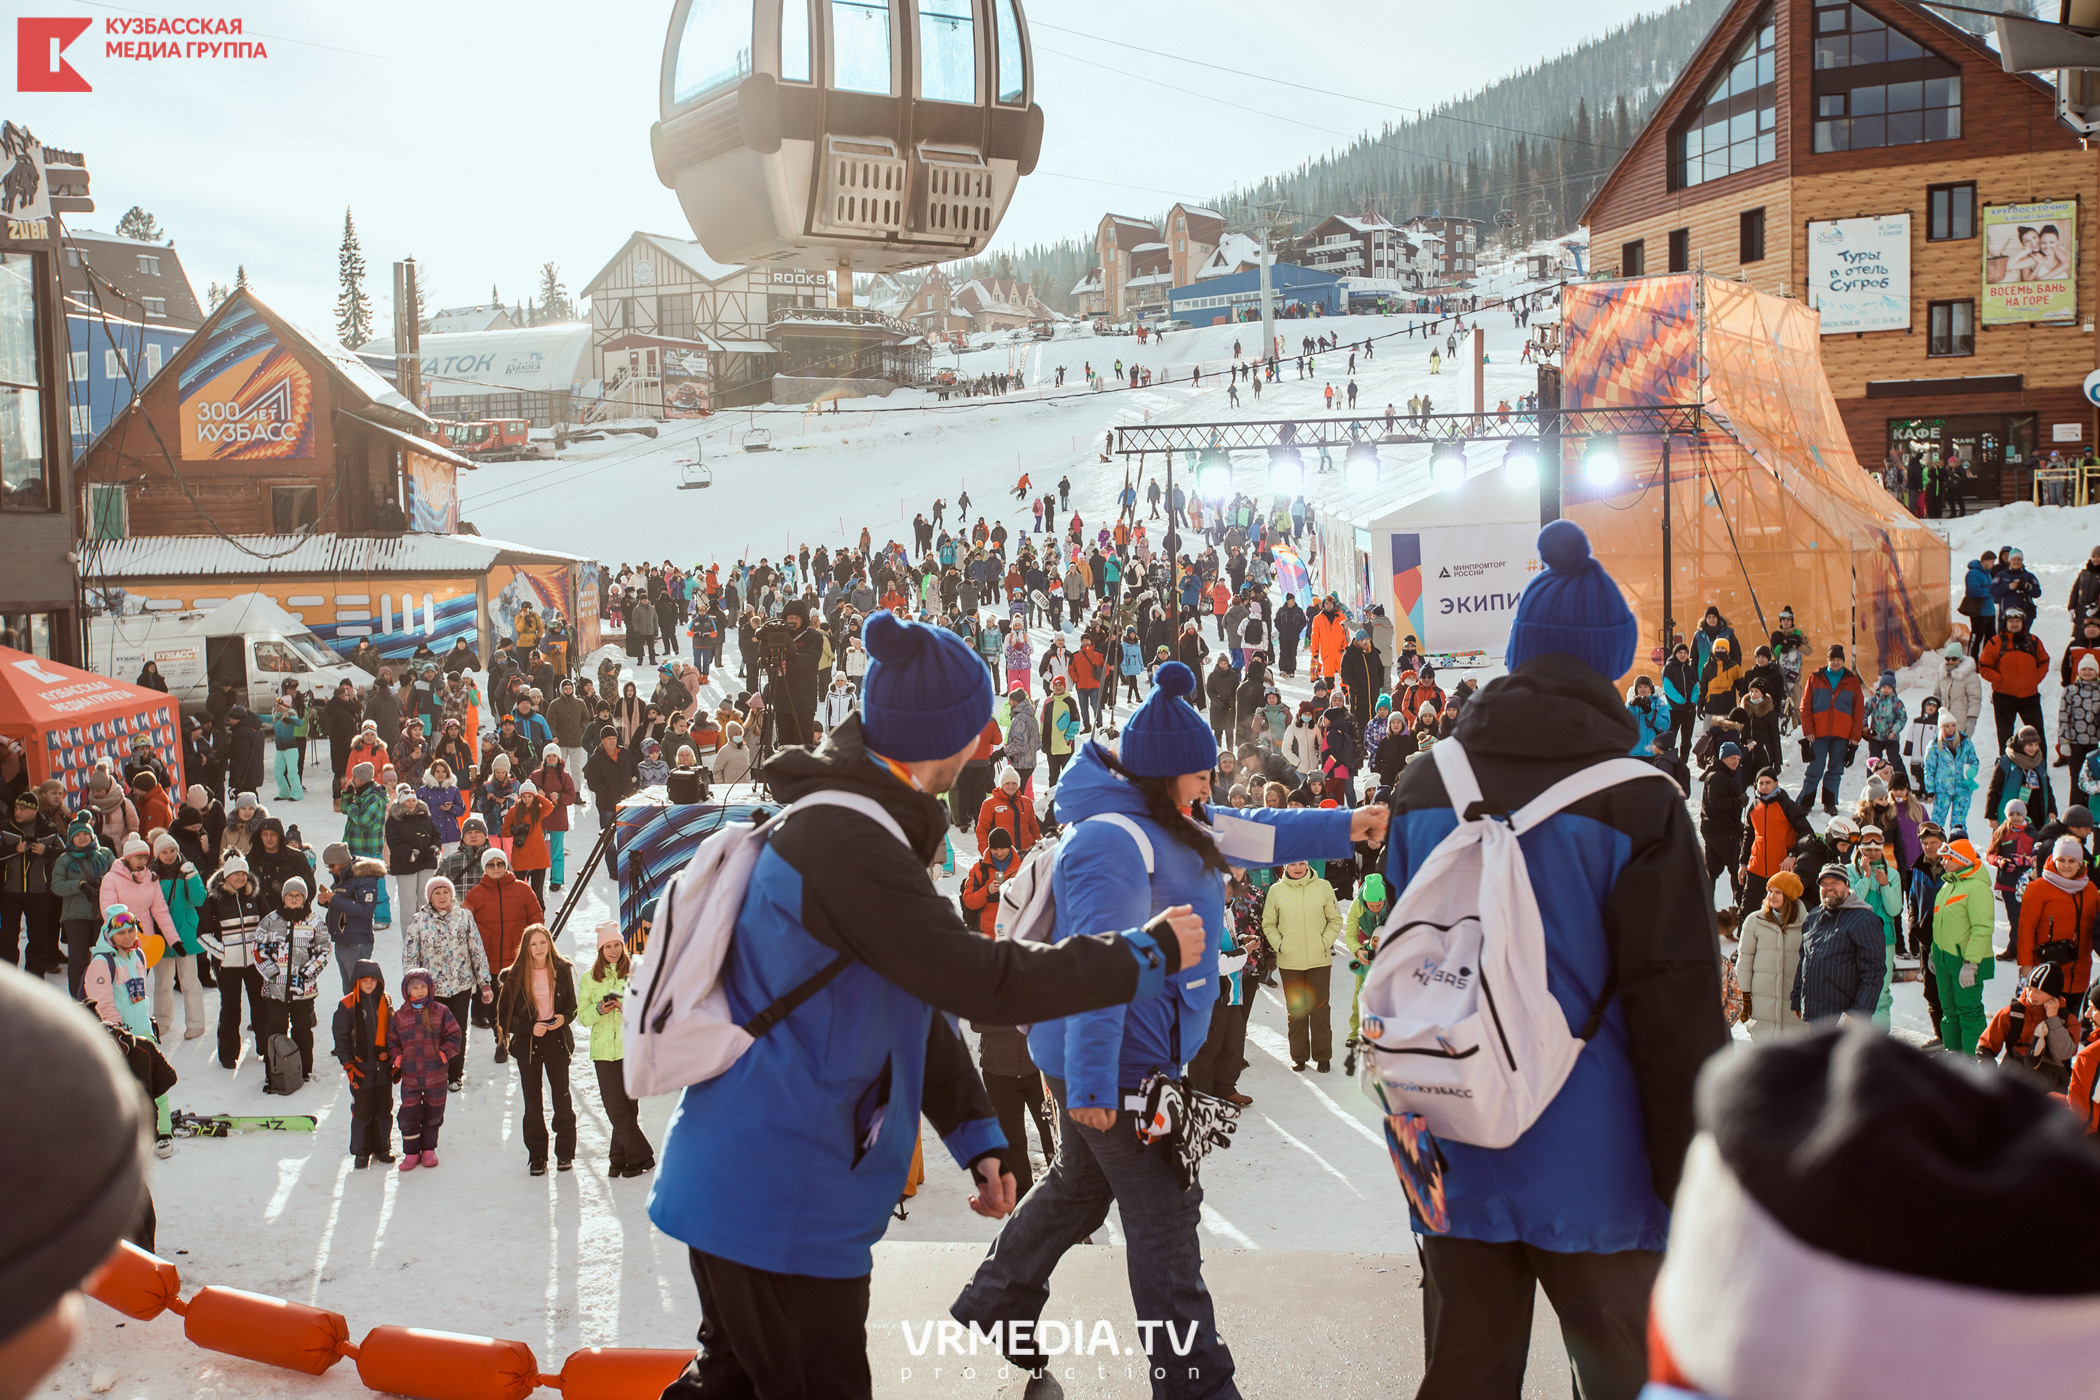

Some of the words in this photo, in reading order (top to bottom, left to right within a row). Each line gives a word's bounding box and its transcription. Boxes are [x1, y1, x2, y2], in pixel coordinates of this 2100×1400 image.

[8, 220, 49, 239] ZUBR
[1837, 250, 1881, 264] Туры
[773, 273, 826, 284] ROOKS
[1830, 269, 1840, 278] в
[1845, 265, 1889, 276] отель
[1829, 277, 1889, 292] Сугроб
[1990, 285, 2033, 297] ВОСЕМЬ
[2036, 283, 2066, 294] БАНЬ
[2005, 297, 2019, 307] НА
[2022, 295, 2050, 306] ГОРЕ
[420, 353, 497, 375] АТОК
[197, 402, 240, 421] 300
[197, 422, 297, 442] КУЗБАСС
[1893, 427, 1941, 440] КАФЕ
[1453, 561, 1507, 571] МИНПРОМТОРГ
[155, 651, 193, 662] КУЗБАСС
[37, 681, 112, 701] КУЗБАССКАЯ
